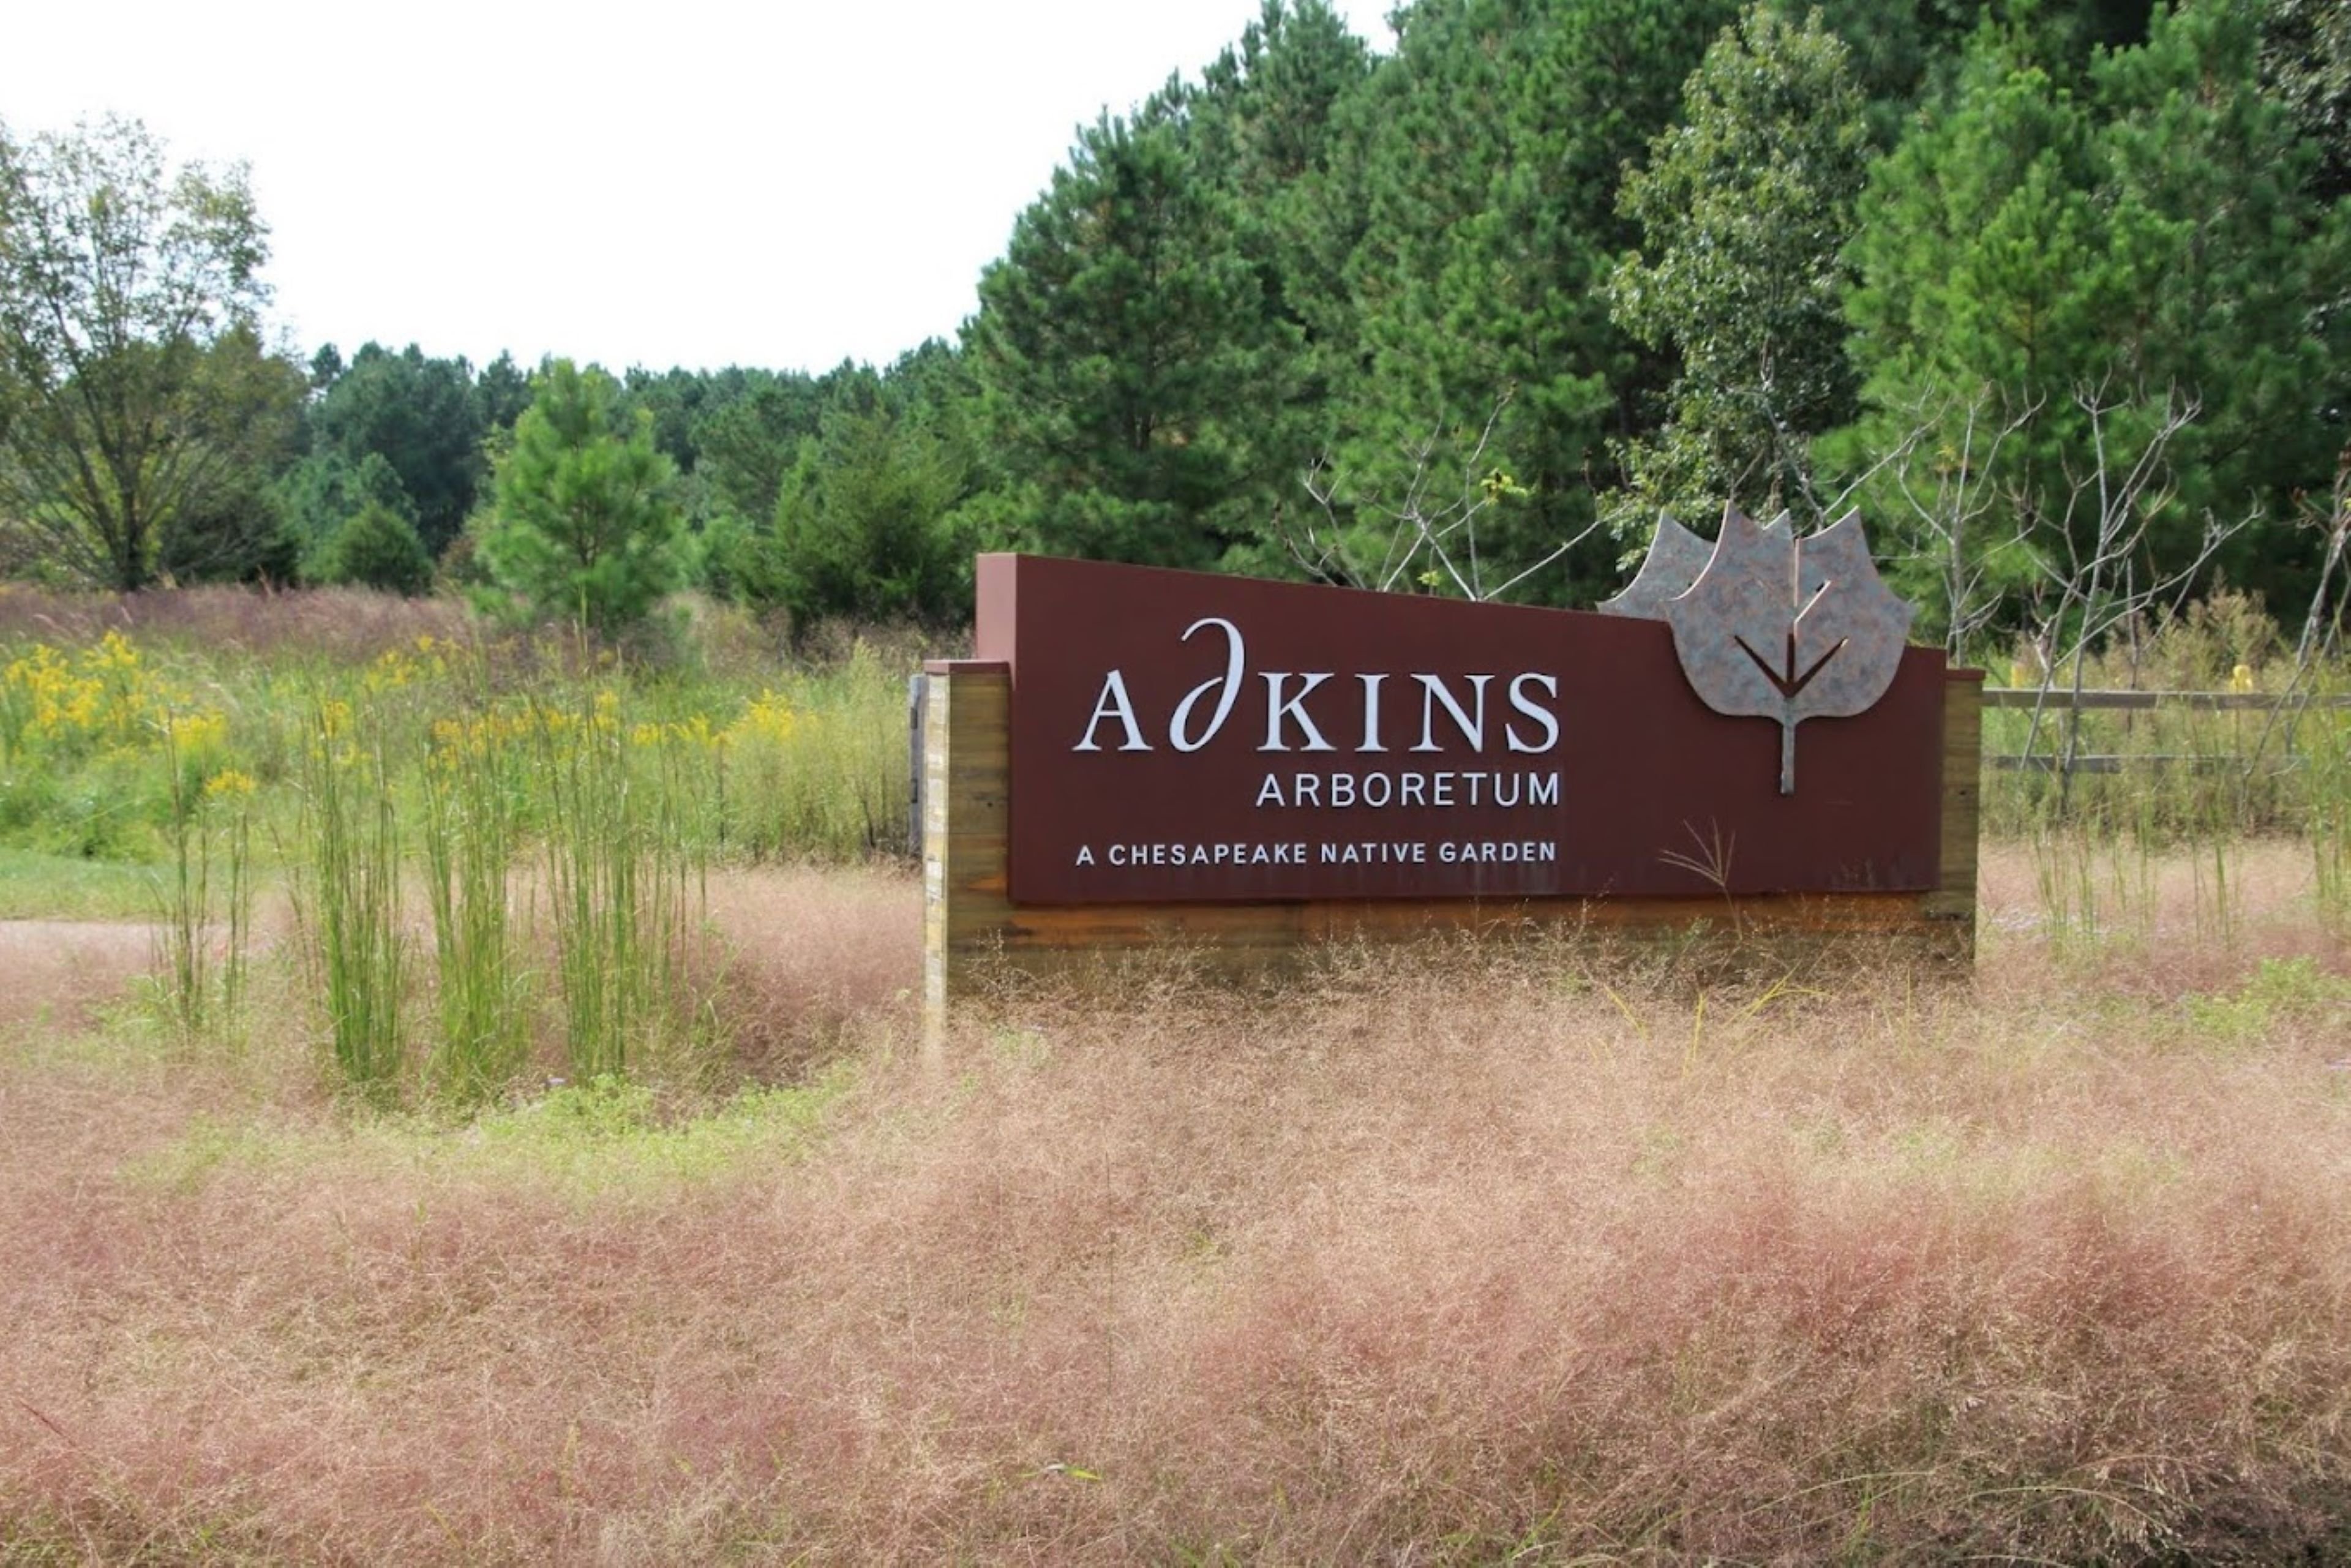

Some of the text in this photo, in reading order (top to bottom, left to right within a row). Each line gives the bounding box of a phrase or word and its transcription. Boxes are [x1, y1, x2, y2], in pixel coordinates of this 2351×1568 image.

[1255, 772, 1559, 808] ARBORETUM
[1076, 841, 1556, 866] A CHESAPEAKE NATIVE GARDEN
